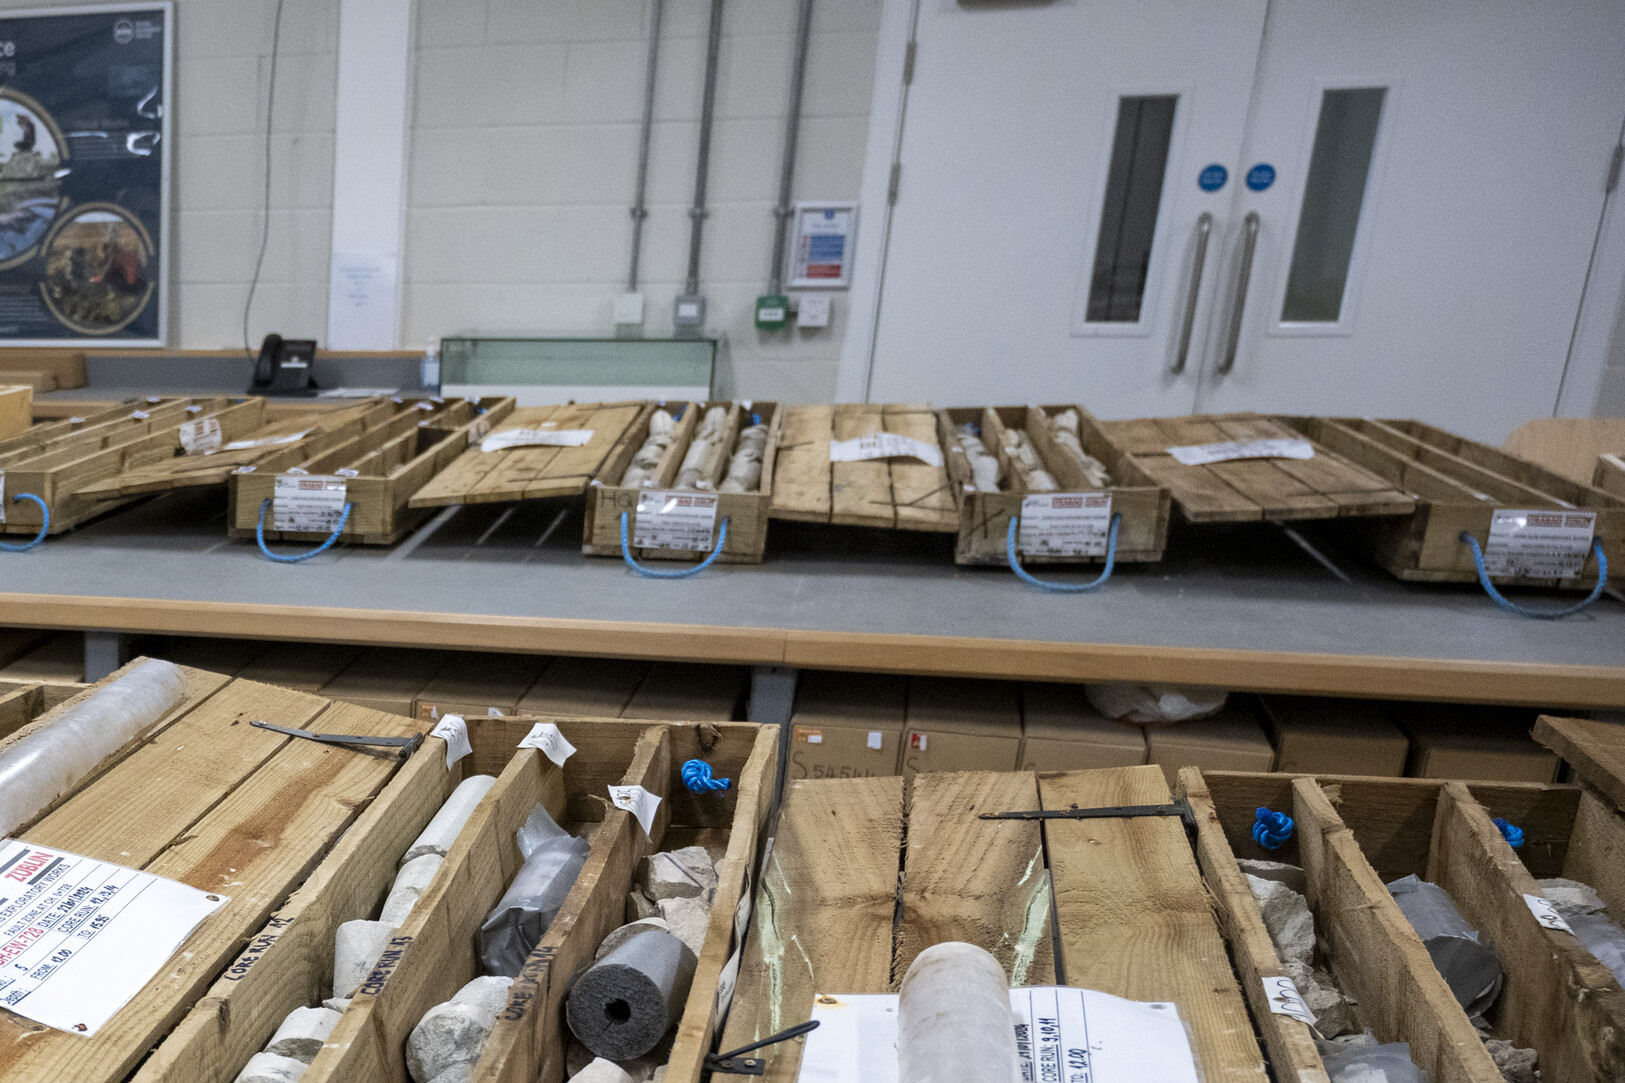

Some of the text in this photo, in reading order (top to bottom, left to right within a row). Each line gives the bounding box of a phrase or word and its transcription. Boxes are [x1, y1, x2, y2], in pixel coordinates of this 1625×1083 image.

[3, 879, 50, 917] EXPLORATORY
[43, 862, 71, 883] WORKS
[3, 921, 26, 937] FAULT
[24, 909, 42, 923] ZONE
[38, 903, 49, 912] AT
[37, 912, 61, 928] DATE:
[14, 963, 29, 972] 5
[57, 916, 82, 933] CORE
[73, 904, 96, 919] RUN:
[223, 917, 295, 982] CORE RUN 12
[29, 963, 55, 981] FROM:
[76, 928, 92, 938] TO:
[359, 970, 392, 996] CORE
[376, 950, 405, 969] RUN
[504, 992, 534, 1021] CORE
[1040, 1044, 1056, 1062] RUN:
[1067, 1048, 1088, 1070] 12.00
[1042, 1060, 1058, 1083] CORE
[1070, 1072, 1085, 1083] TO:
